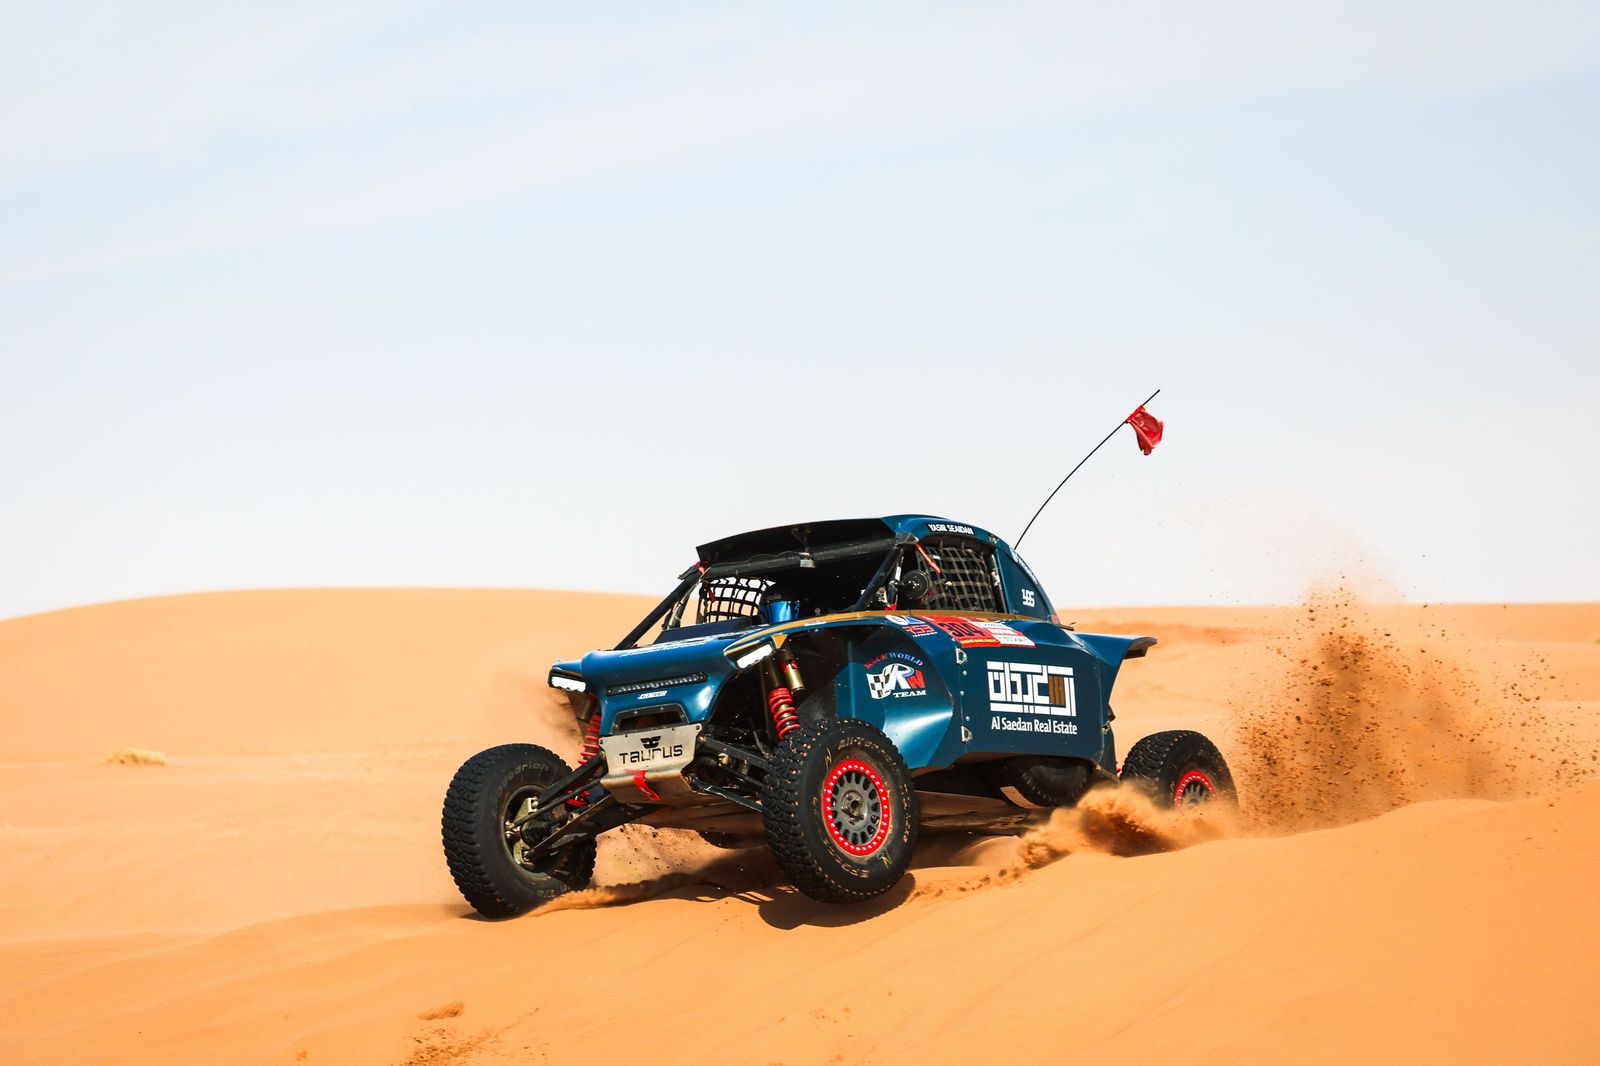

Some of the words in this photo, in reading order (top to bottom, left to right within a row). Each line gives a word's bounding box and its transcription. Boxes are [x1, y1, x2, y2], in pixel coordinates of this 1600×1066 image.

[927, 523, 948, 532] YASIR
[937, 622, 987, 638] 304
[888, 652, 924, 666] WORLD
[892, 690, 927, 699] TEAM
[991, 715, 1000, 730] Al
[1001, 717, 1033, 731] Saedan
[1033, 719, 1052, 733] Real
[1052, 720, 1078, 735] Estate
